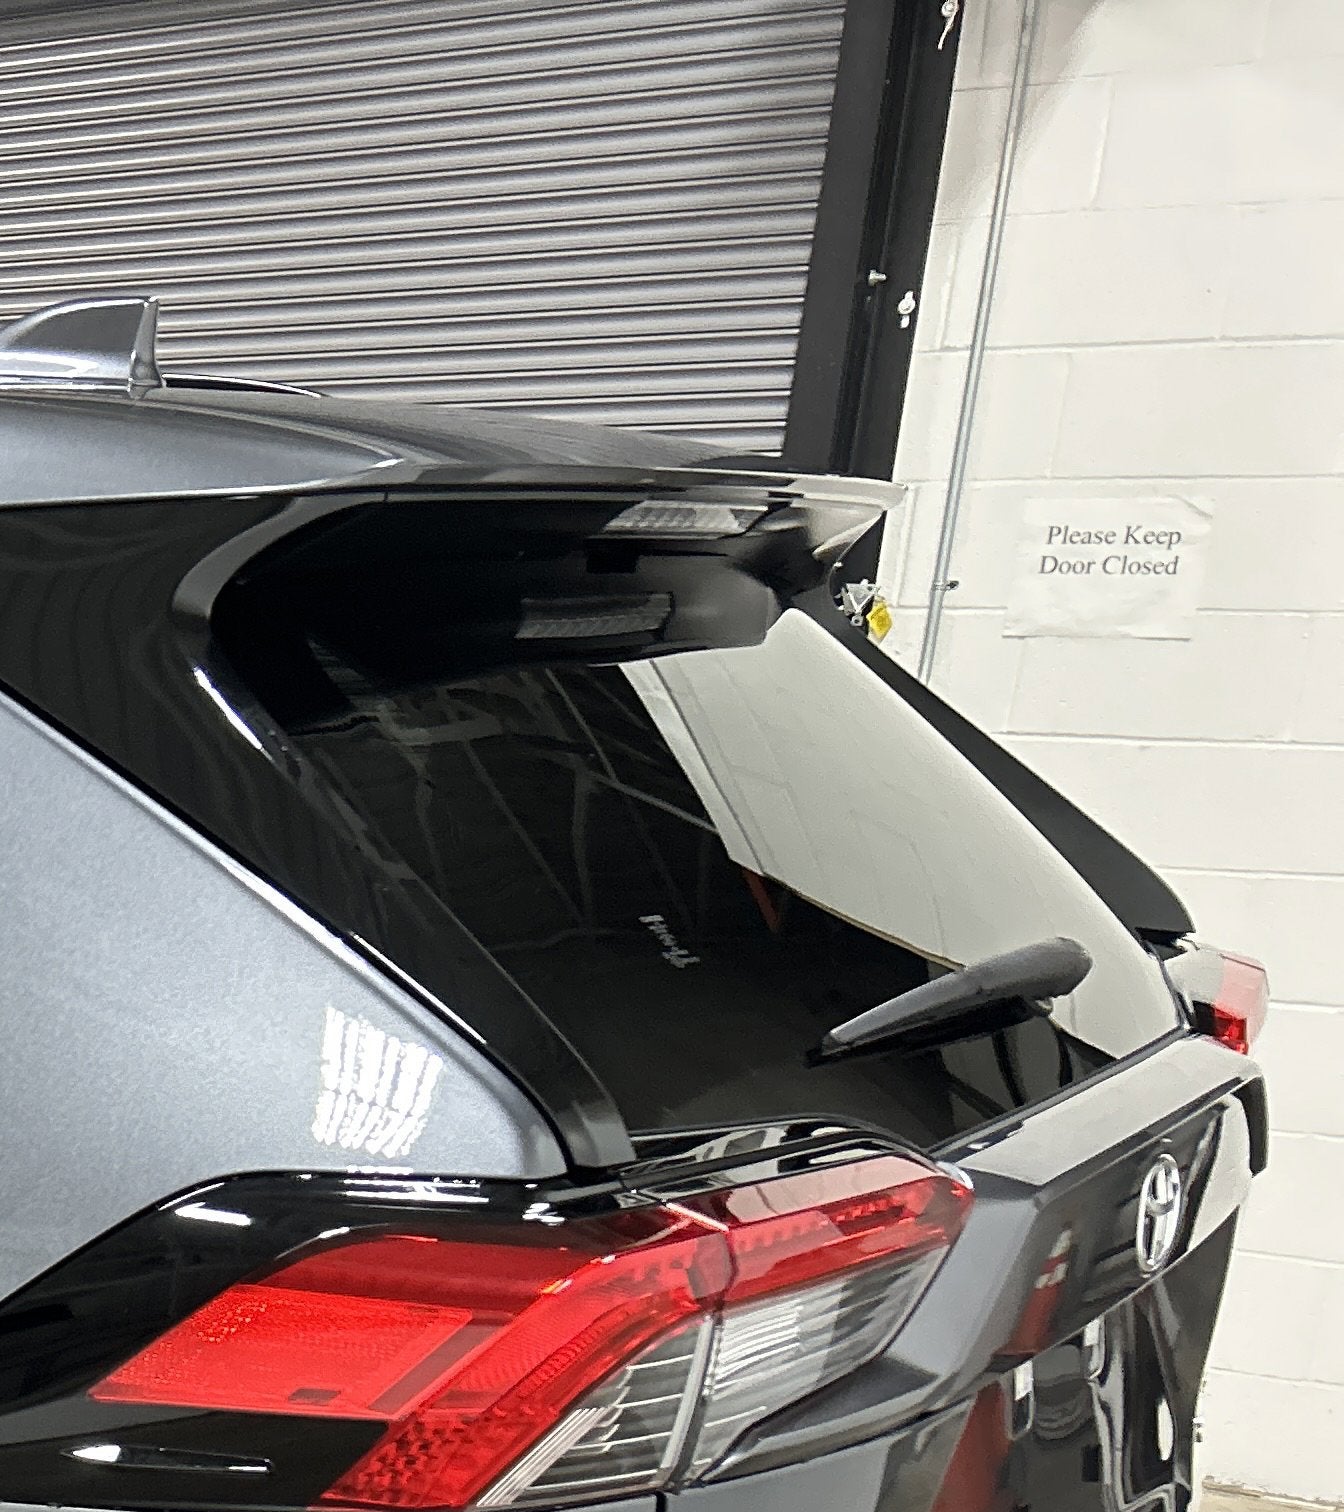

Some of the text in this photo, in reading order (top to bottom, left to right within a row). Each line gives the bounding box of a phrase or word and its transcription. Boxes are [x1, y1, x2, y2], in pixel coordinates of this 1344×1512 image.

[1046, 524, 1182, 550] Please Keep
[1038, 554, 1180, 576] Door Closed
